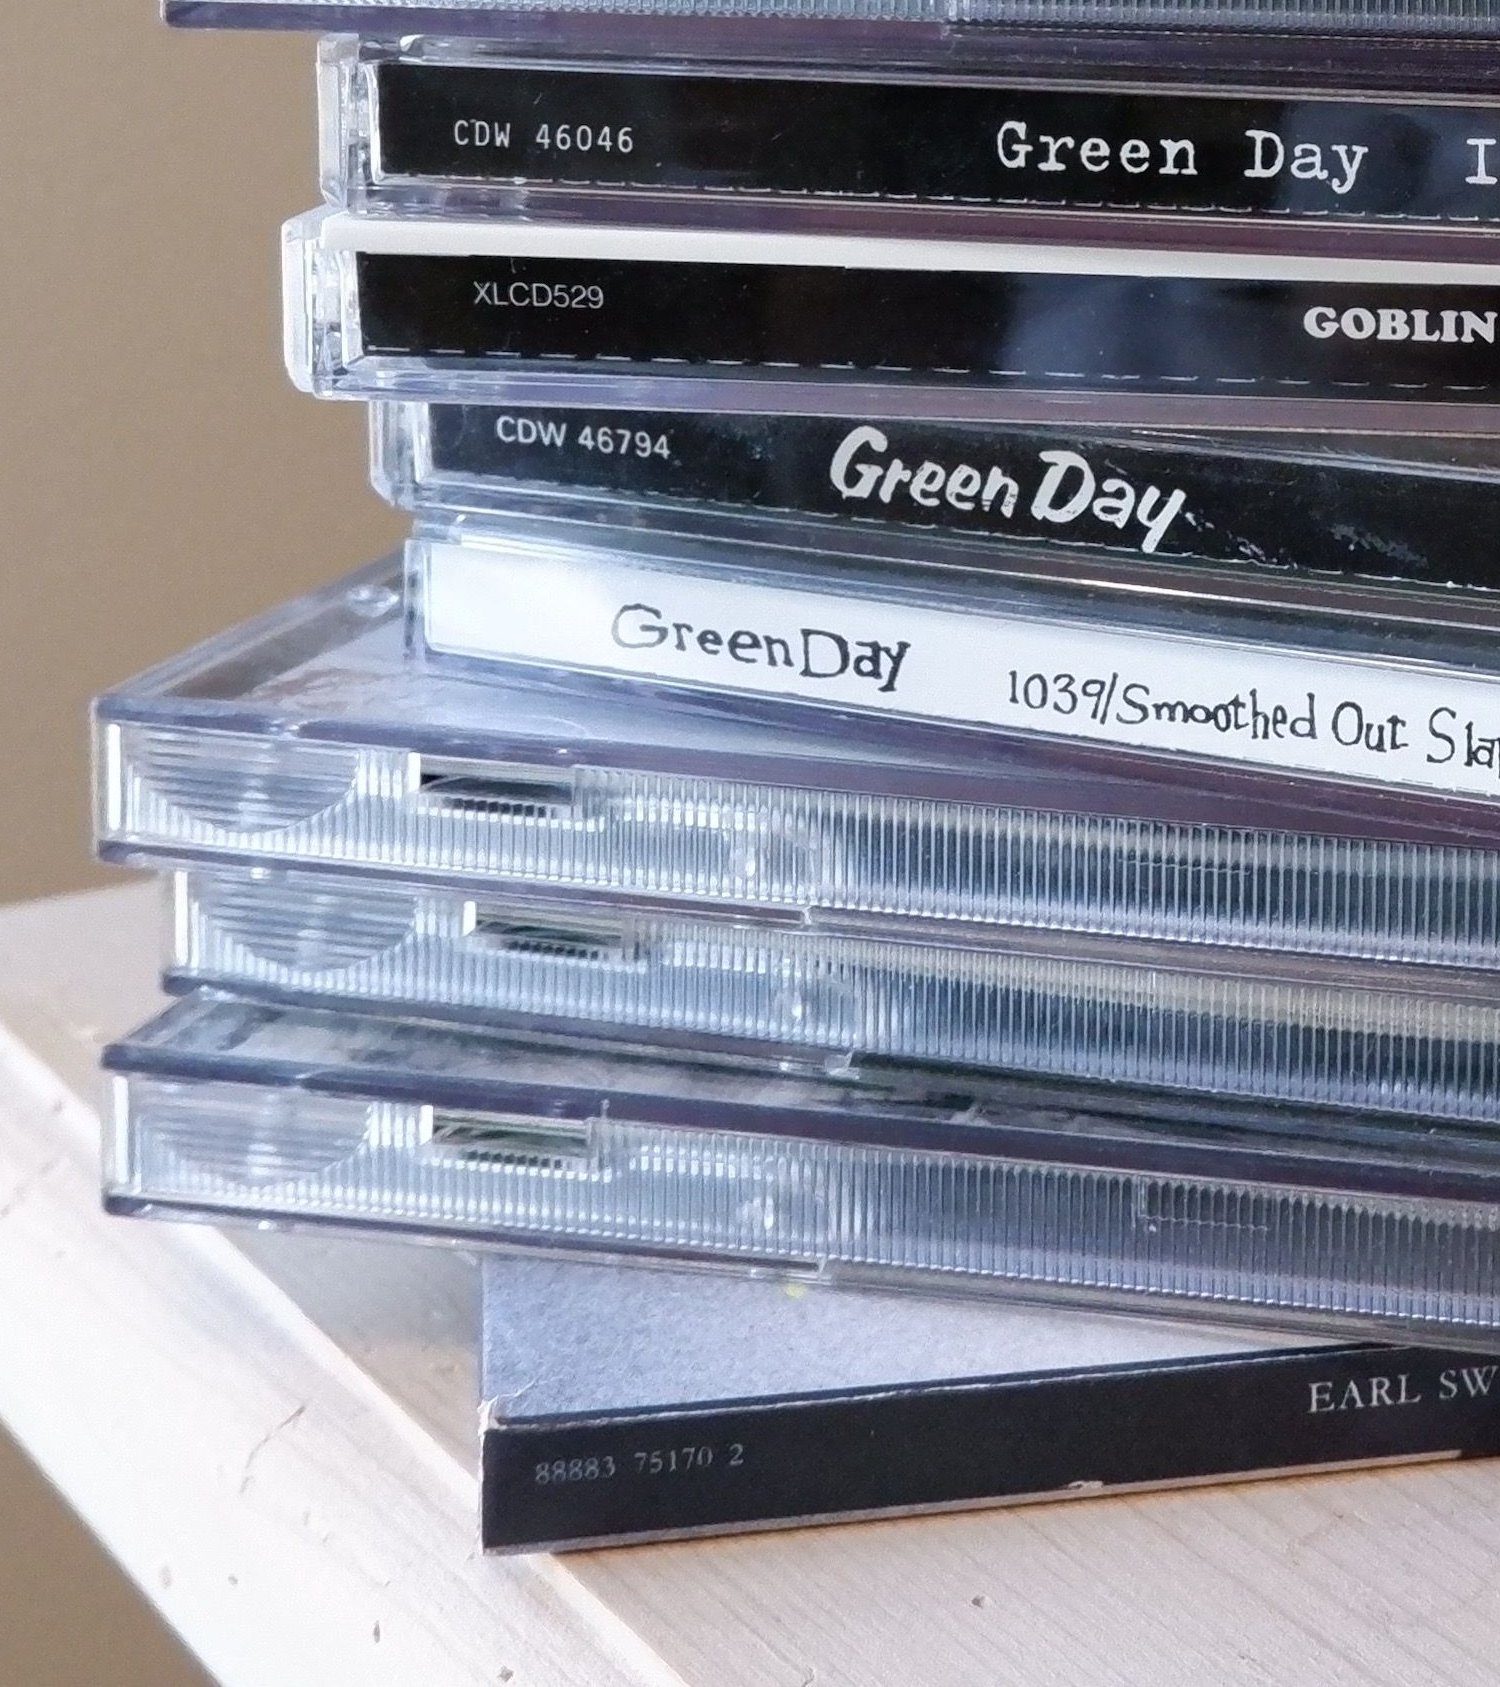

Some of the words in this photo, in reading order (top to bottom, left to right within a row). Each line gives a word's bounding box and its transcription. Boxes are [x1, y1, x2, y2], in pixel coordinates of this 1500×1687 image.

[454, 119, 511, 148] CDW
[535, 123, 633, 153] 46046
[996, 119, 1199, 178] Green
[1243, 128, 1370, 194] Day
[473, 281, 604, 309] XLCD529
[1303, 306, 1498, 344] GOBLIN
[497, 416, 565, 447] CDW
[578, 424, 671, 460] 46794
[829, 425, 1019, 518] Green
[1031, 449, 1188, 554] Day
[1008, 670, 1316, 741] 1039/Smoothed
[1332, 701, 1408, 752] Out
[1307, 1373, 1422, 1413] EARL
[535, 1456, 616, 1485] 88883
[634, 1447, 713, 1474] 75170
[729, 1444, 744, 1466] 2
